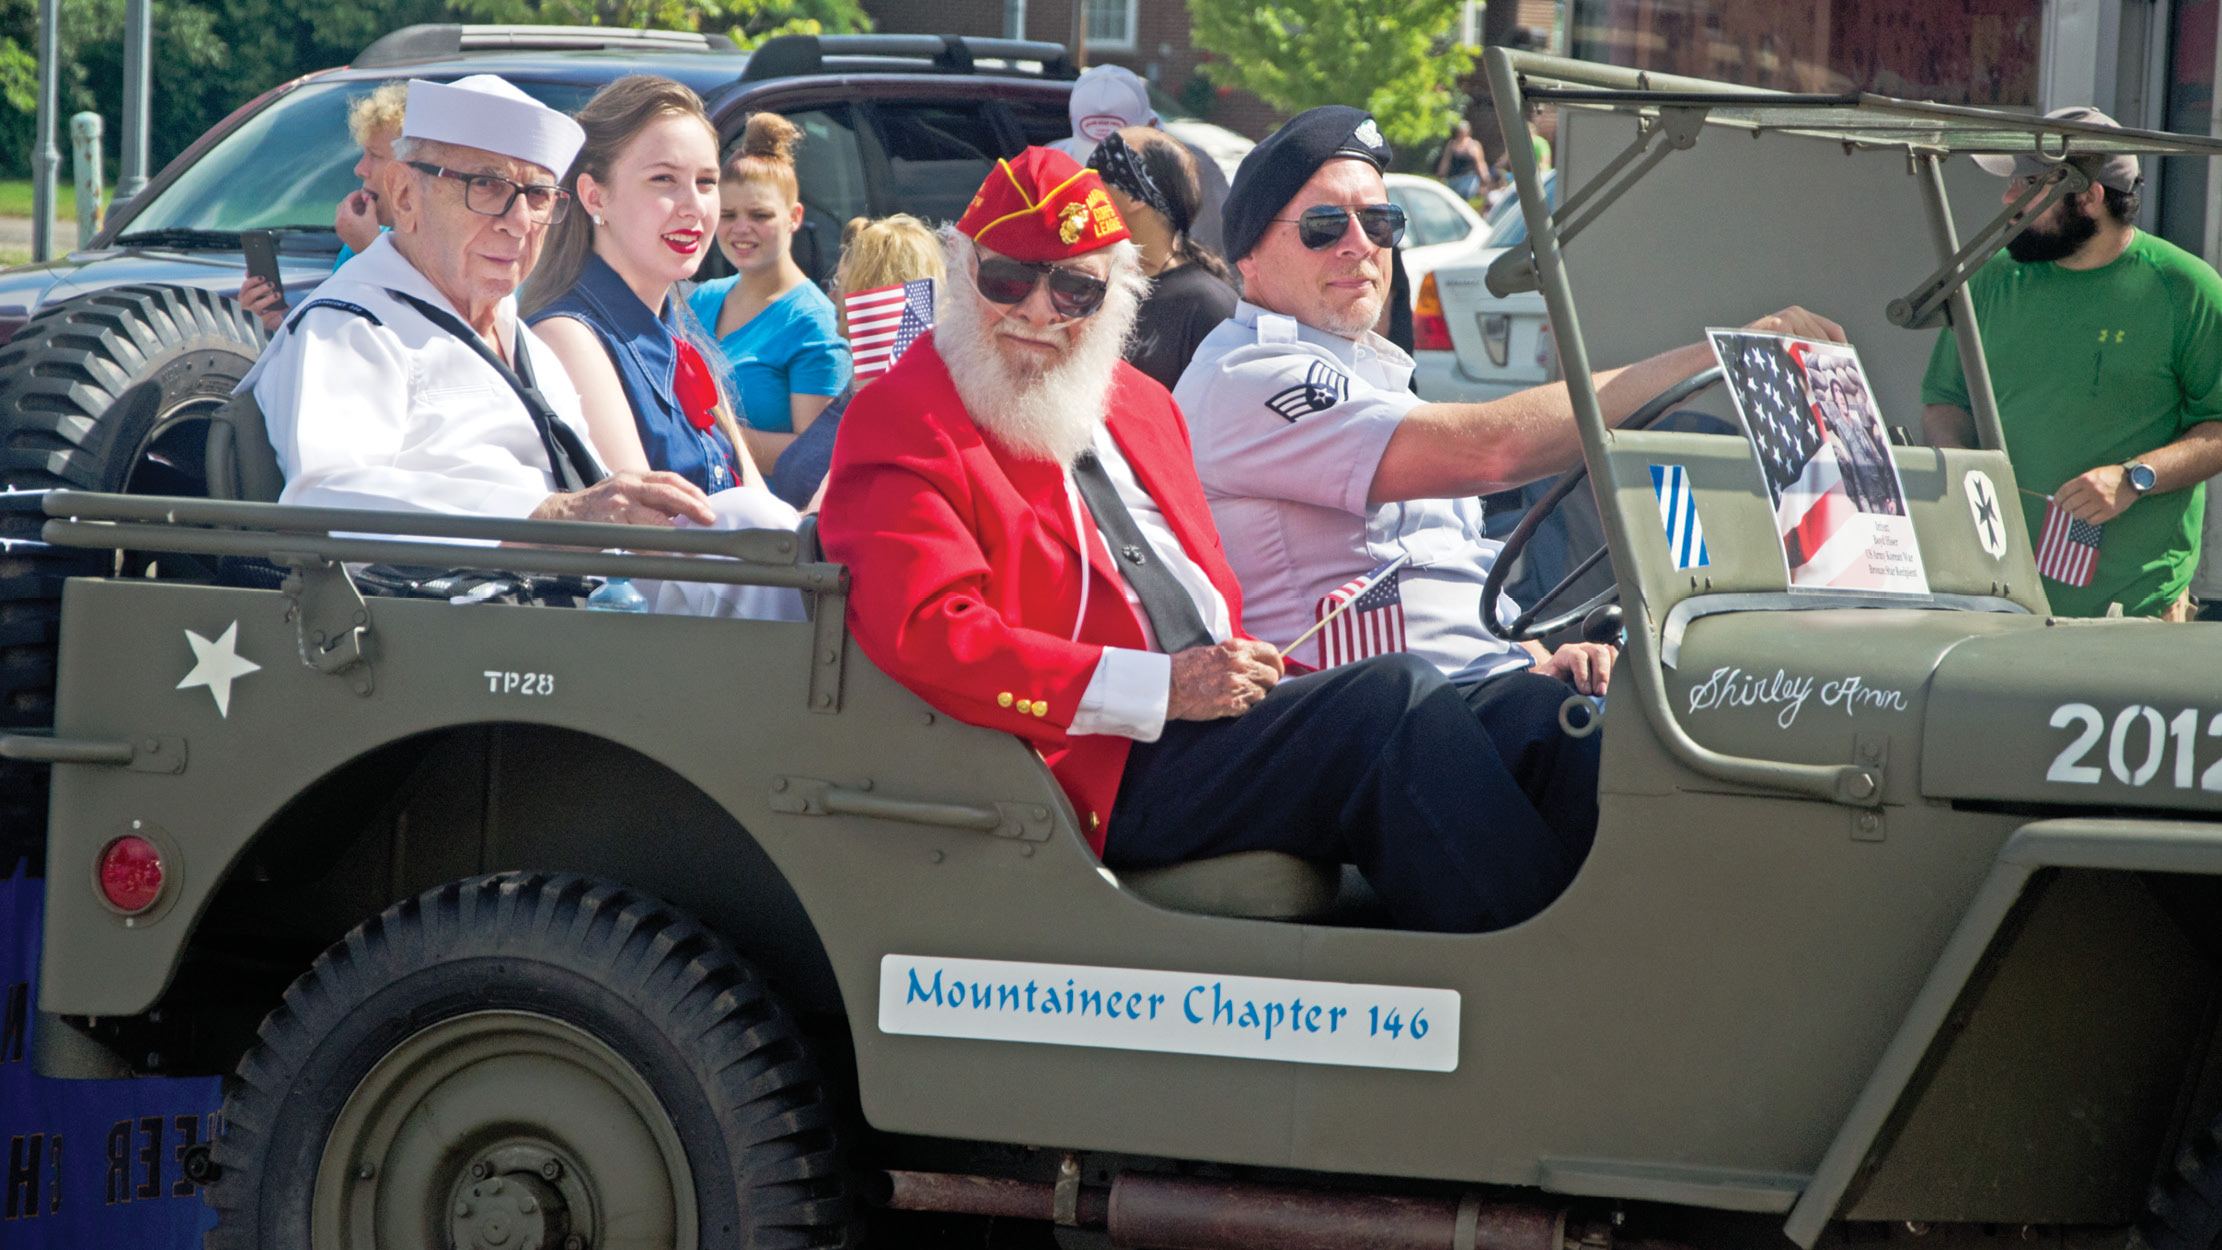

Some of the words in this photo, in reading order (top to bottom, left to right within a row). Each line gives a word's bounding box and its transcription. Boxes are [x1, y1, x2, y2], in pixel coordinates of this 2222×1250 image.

[1093, 204, 1116, 222] CORPS
[1094, 217, 1124, 238] LEAGUE
[483, 671, 555, 695] TP28
[1688, 666, 1814, 729] Shirley
[1820, 676, 1907, 716] Ann
[906, 967, 1165, 1021] Mountaineer
[1183, 981, 1348, 1041] Chapter
[1368, 1004, 1429, 1040] 146
